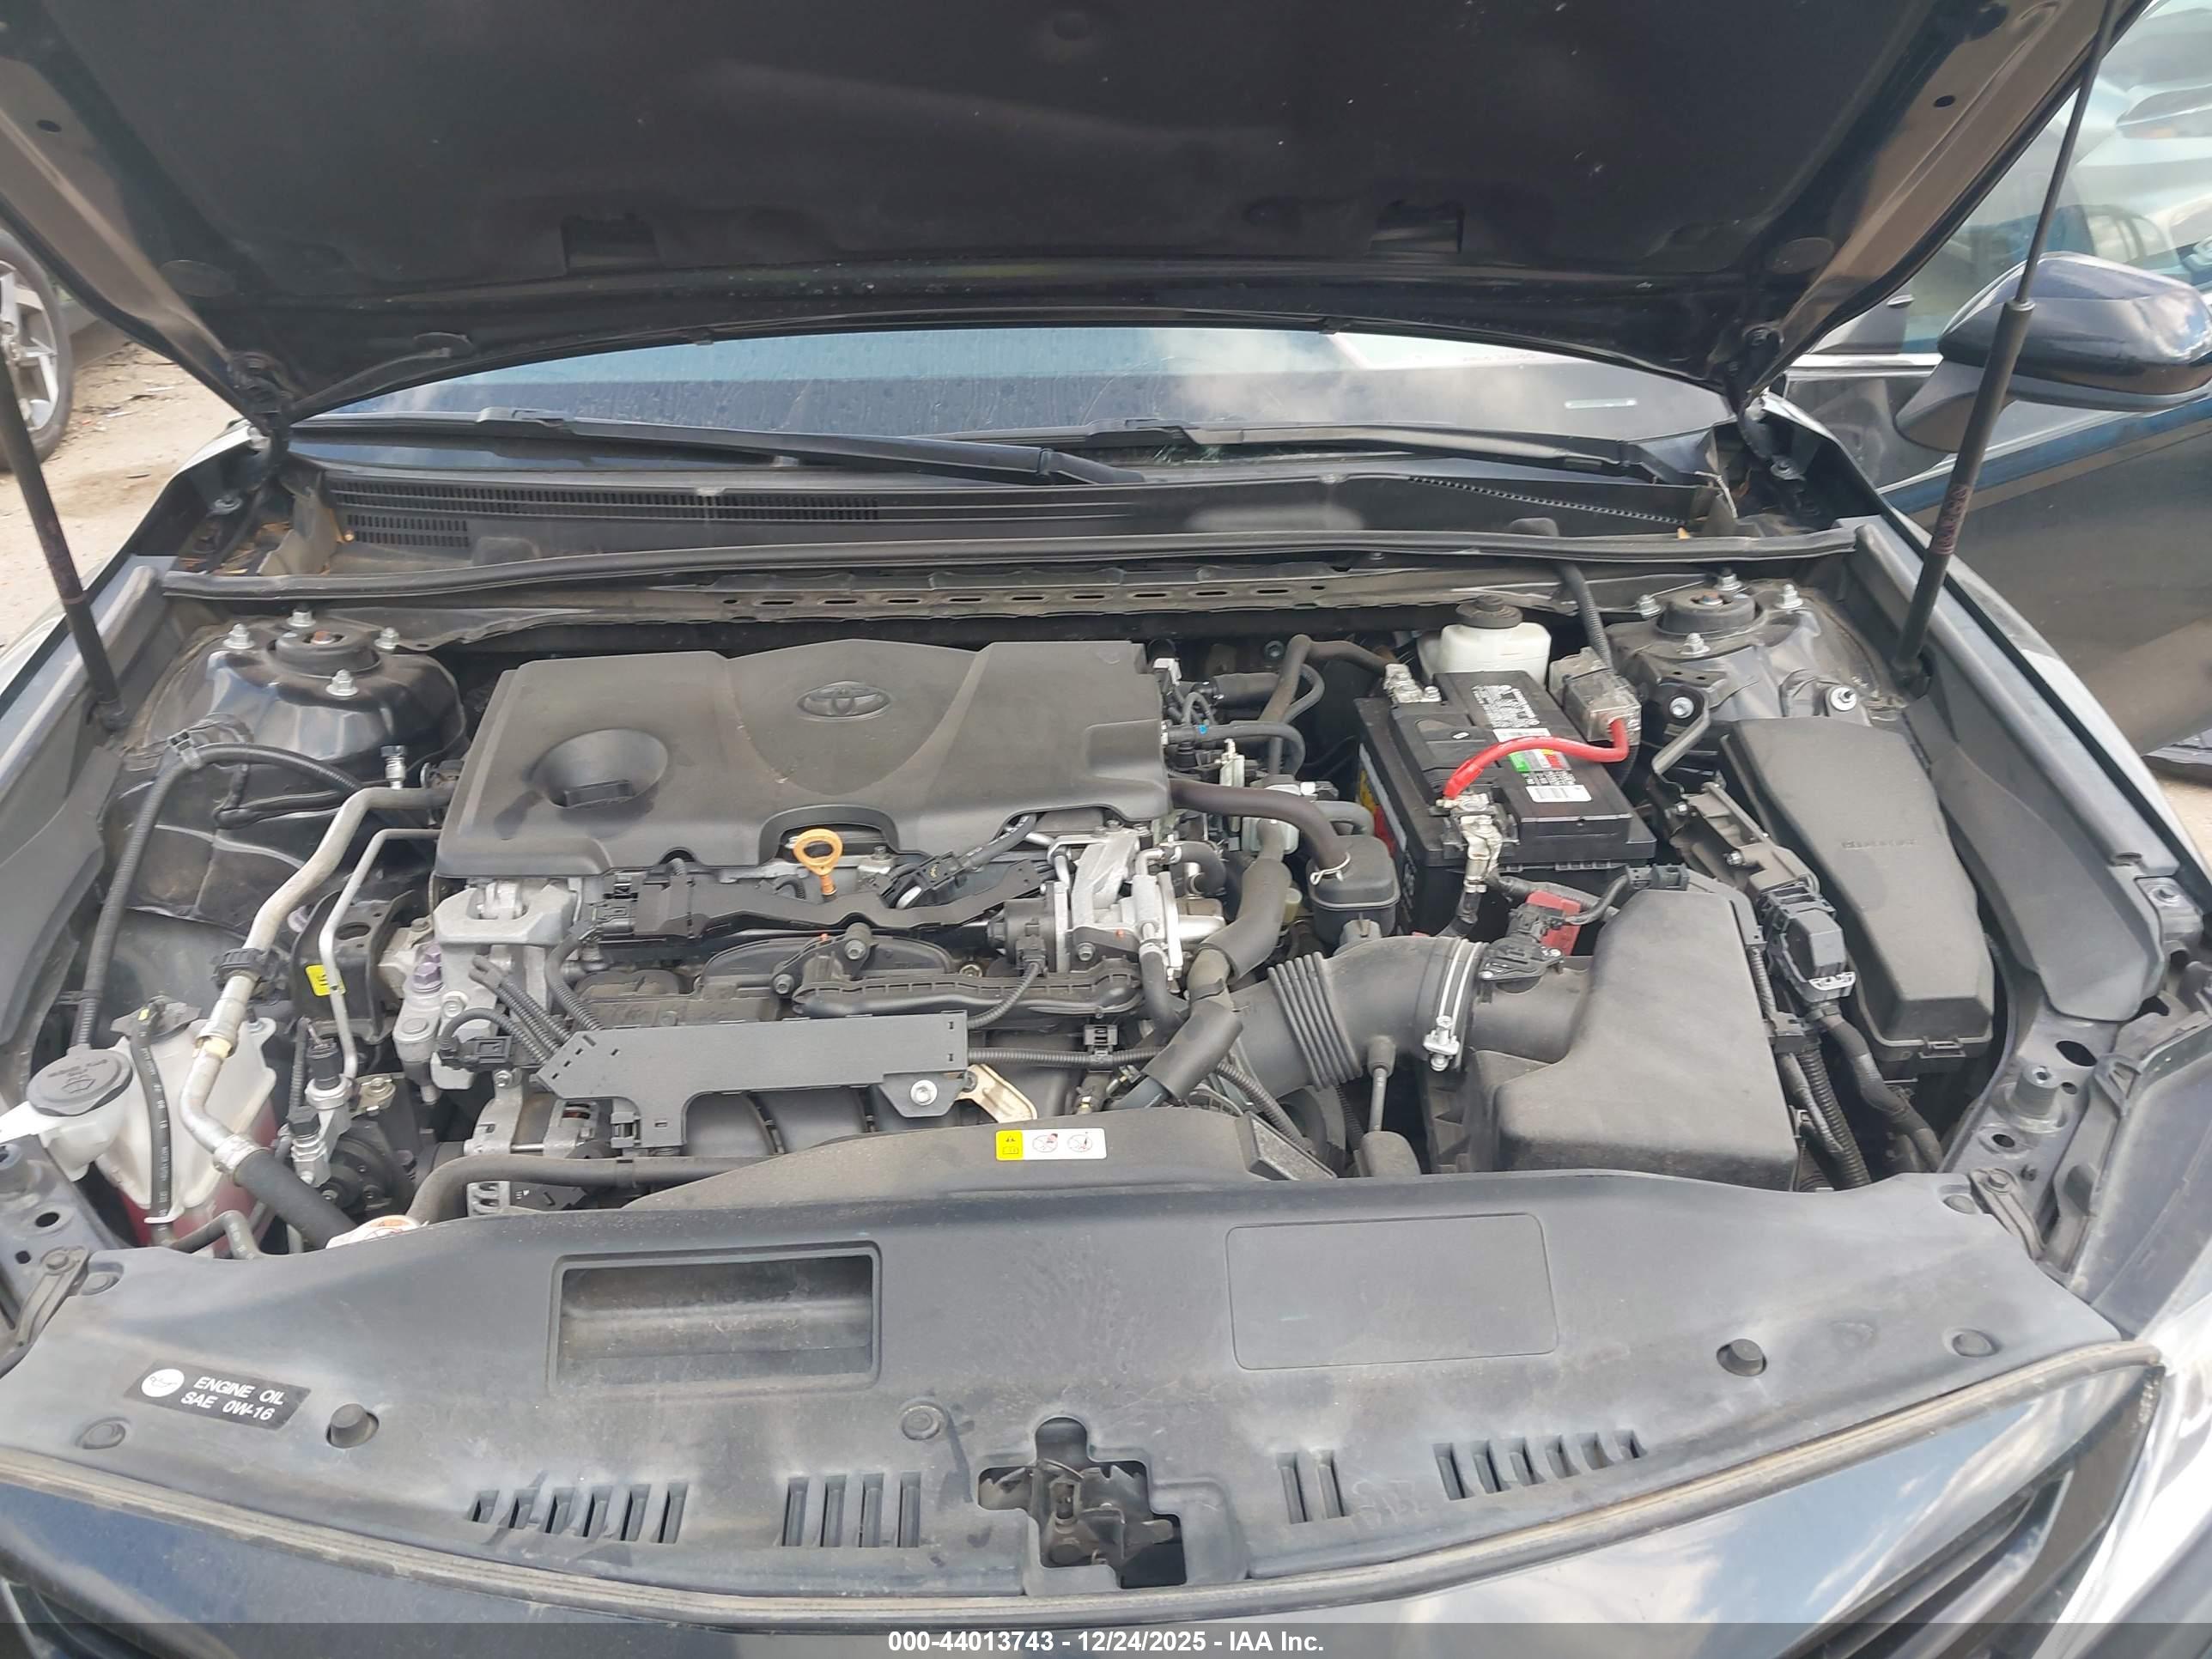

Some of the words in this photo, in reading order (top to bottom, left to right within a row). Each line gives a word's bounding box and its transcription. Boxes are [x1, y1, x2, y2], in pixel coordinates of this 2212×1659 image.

[180, 1391, 219, 1409] SAE
[222, 1400, 276, 1421] 0W-16
[193, 1376, 256, 1399] ENGINE
[258, 1389, 286, 1406] OIL
